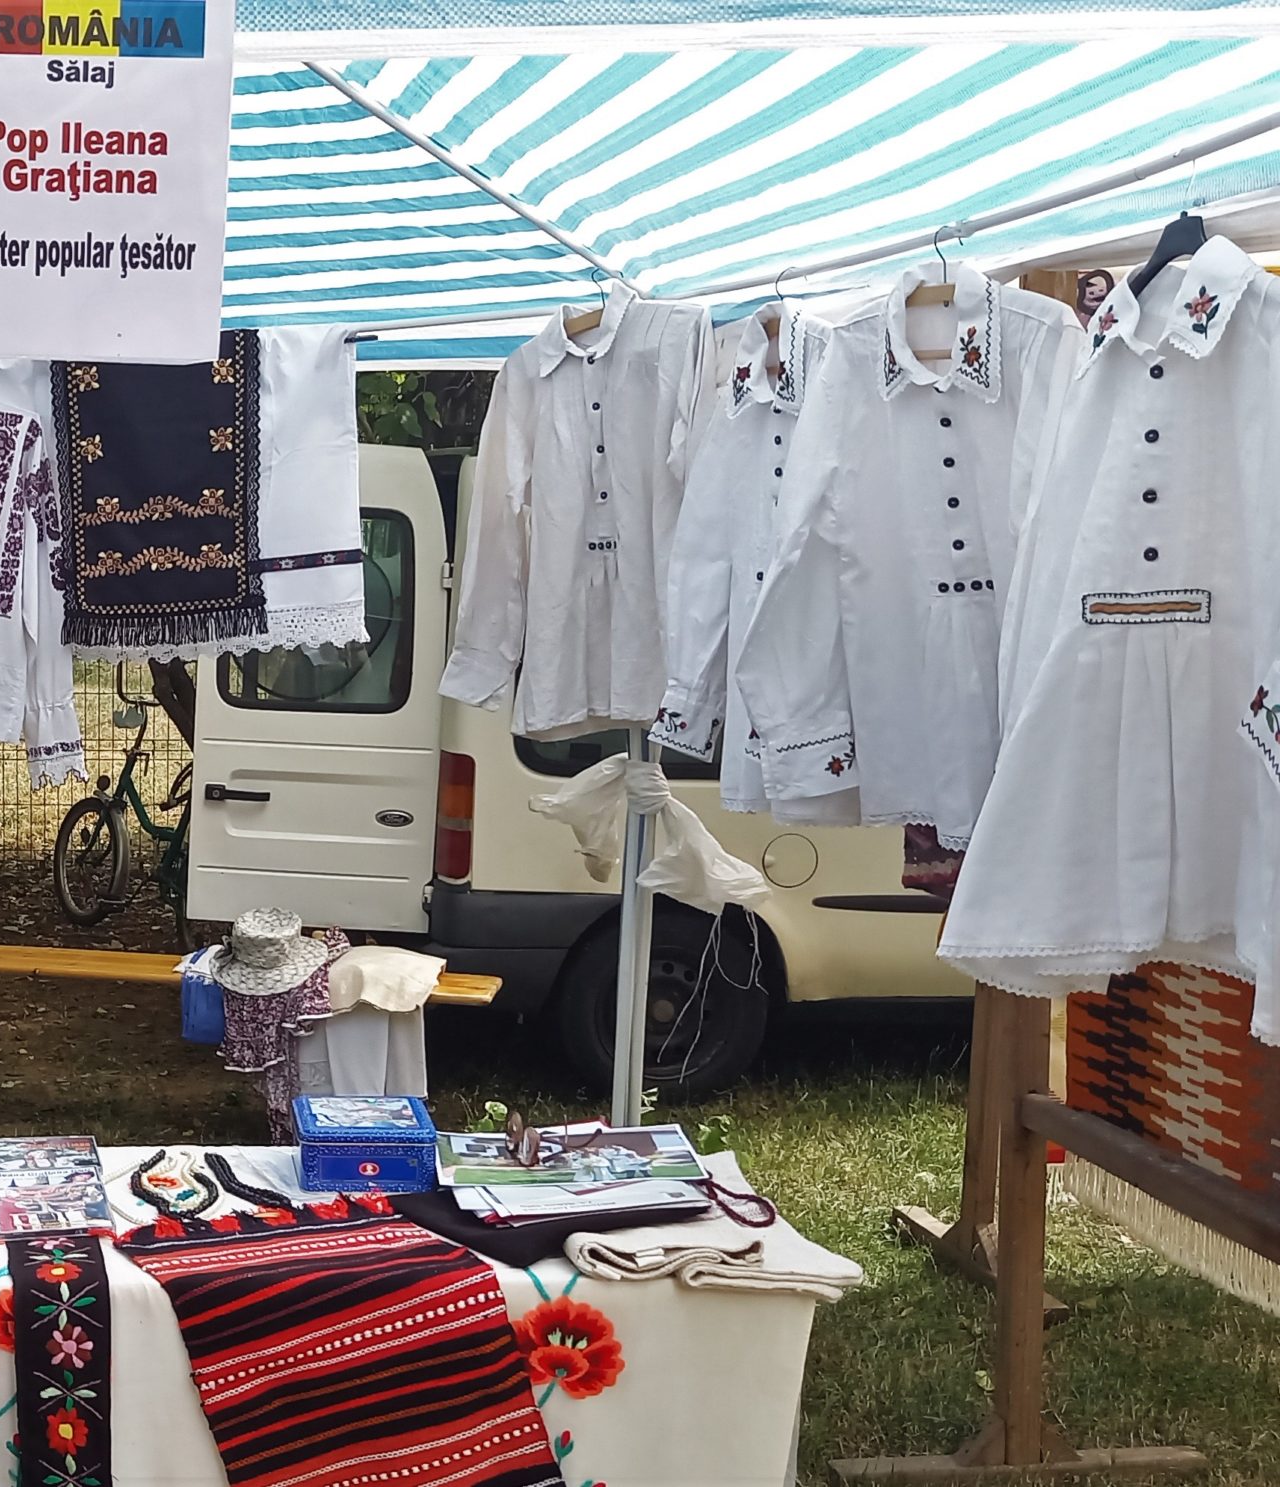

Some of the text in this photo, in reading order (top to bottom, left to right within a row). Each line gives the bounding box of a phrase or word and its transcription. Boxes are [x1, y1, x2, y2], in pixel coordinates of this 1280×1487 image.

[46, 59, 115, 88] Sălaj
[61, 122, 168, 156] Ileana
[3, 160, 157, 200] Graţiana
[35, 232, 114, 277] popular
[120, 233, 196, 278] ţesător
